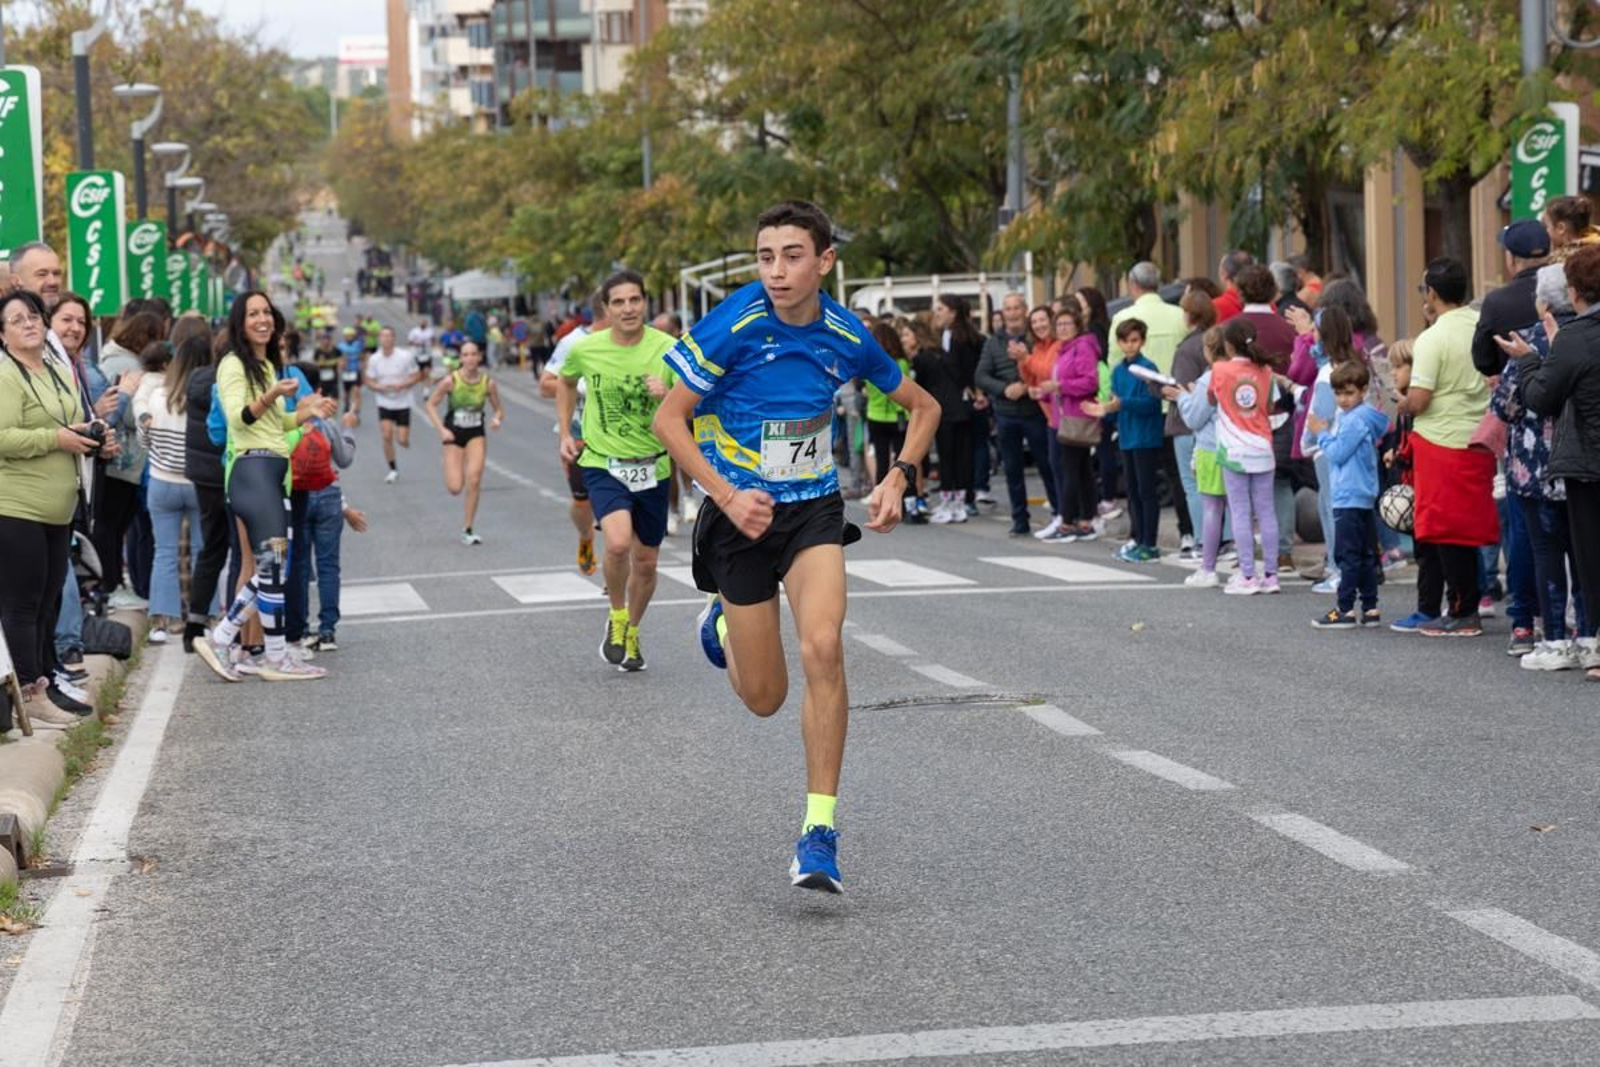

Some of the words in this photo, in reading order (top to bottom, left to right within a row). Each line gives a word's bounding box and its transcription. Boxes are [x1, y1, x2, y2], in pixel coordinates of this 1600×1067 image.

[86, 220, 103, 310] CSIF
[790, 436, 817, 464] 74
[620, 467, 648, 483] 323
